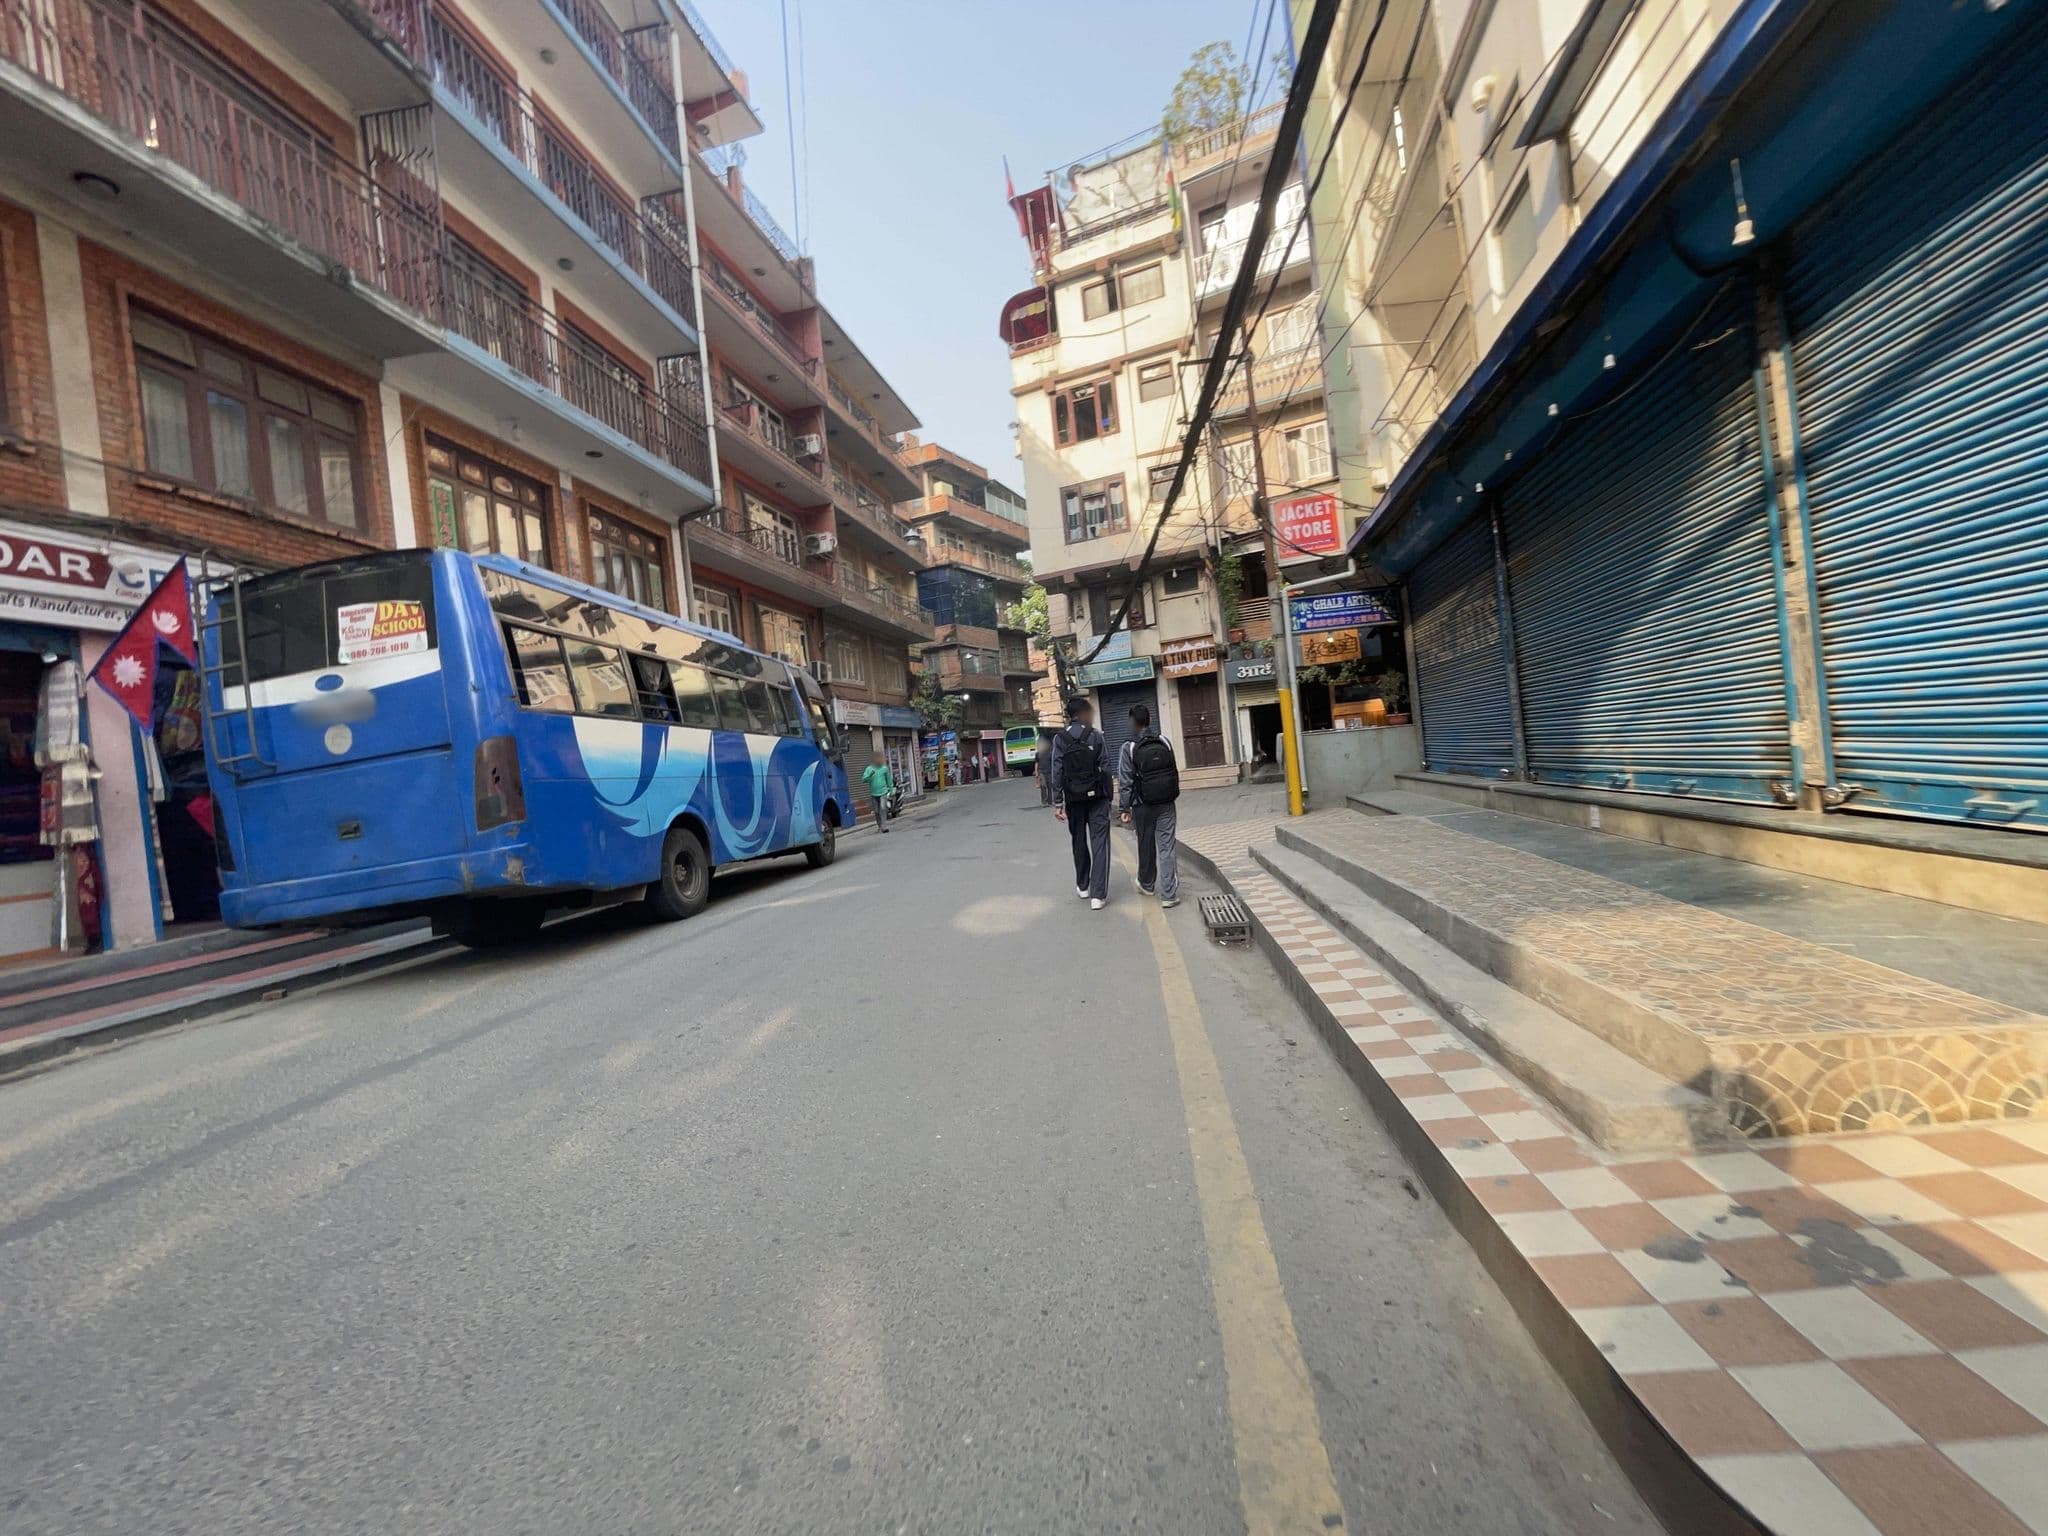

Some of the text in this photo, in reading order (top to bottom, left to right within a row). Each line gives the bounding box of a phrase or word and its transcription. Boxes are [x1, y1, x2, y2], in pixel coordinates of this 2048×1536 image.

[1280, 500, 1332, 522] JACKET
[1283, 519, 1332, 541] STORE
[1313, 595, 1371, 610] GHALE ARTS
[374, 616, 424, 637] SCHOOL
[1171, 649, 1194, 665] TINY
[1197, 647, 1215, 660] PUB
